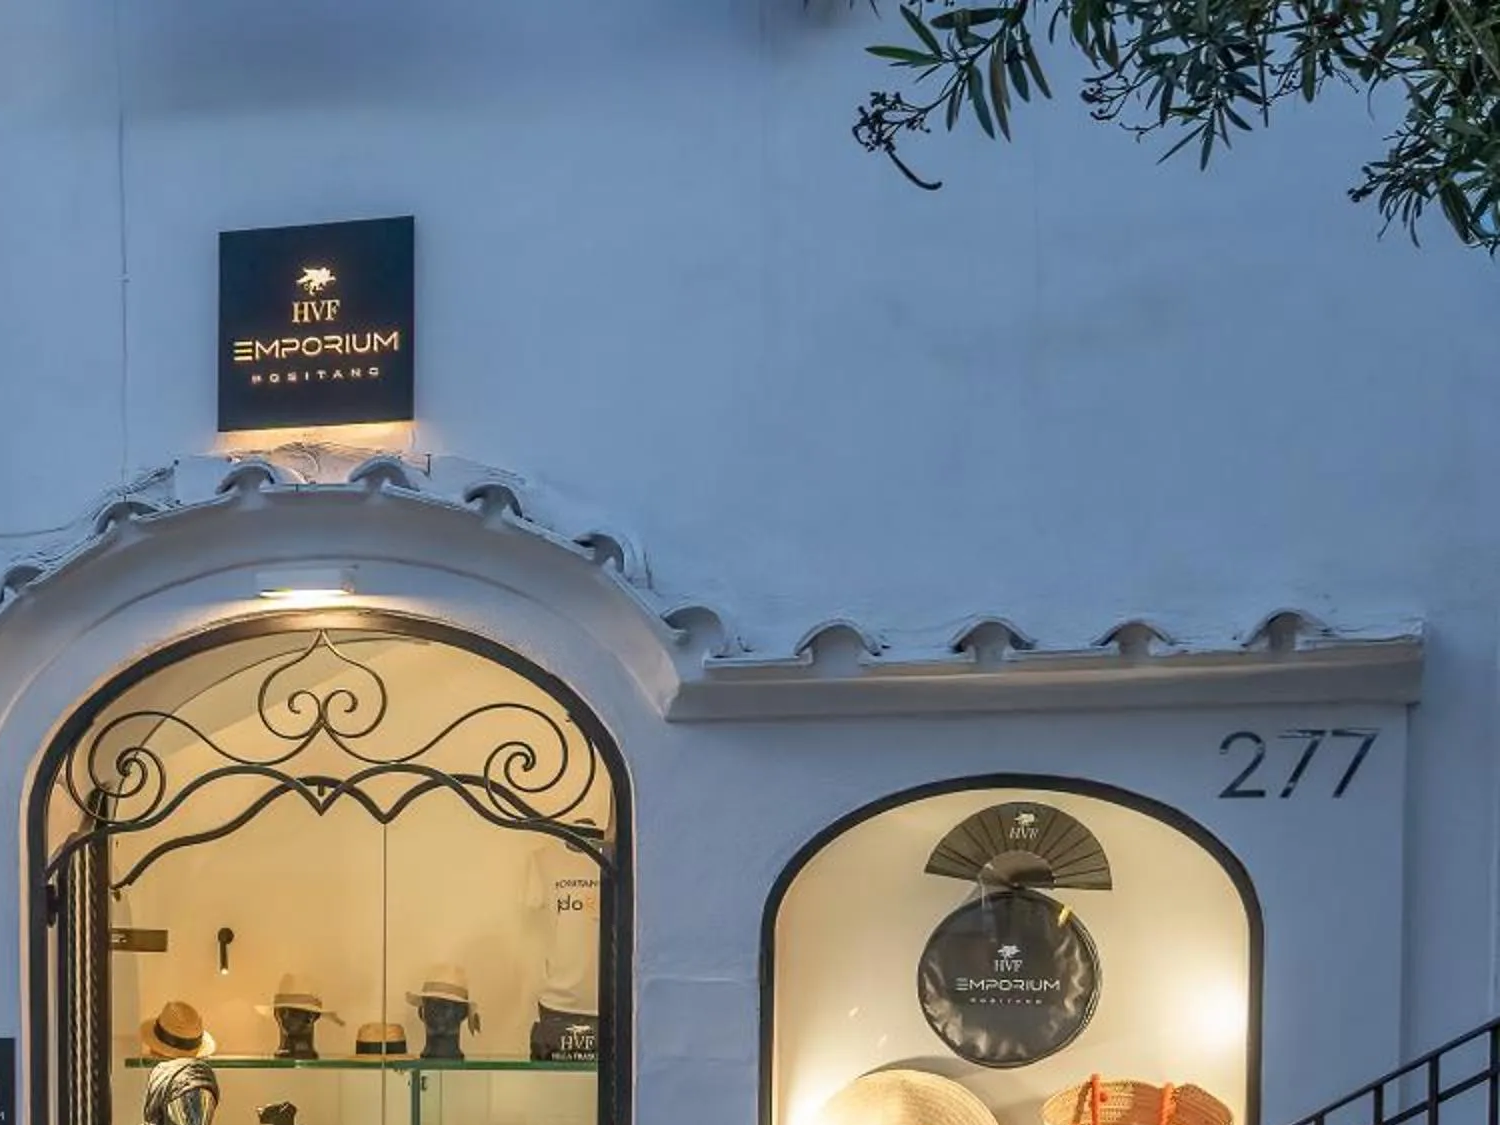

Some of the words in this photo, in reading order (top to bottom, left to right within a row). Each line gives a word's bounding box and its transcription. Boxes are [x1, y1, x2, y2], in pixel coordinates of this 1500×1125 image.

[291, 299, 341, 323] HVF
[233, 331, 400, 362] EMPORIUM
[1218, 728, 1382, 799] 277
[955, 977, 1061, 992] EMPORIUM
